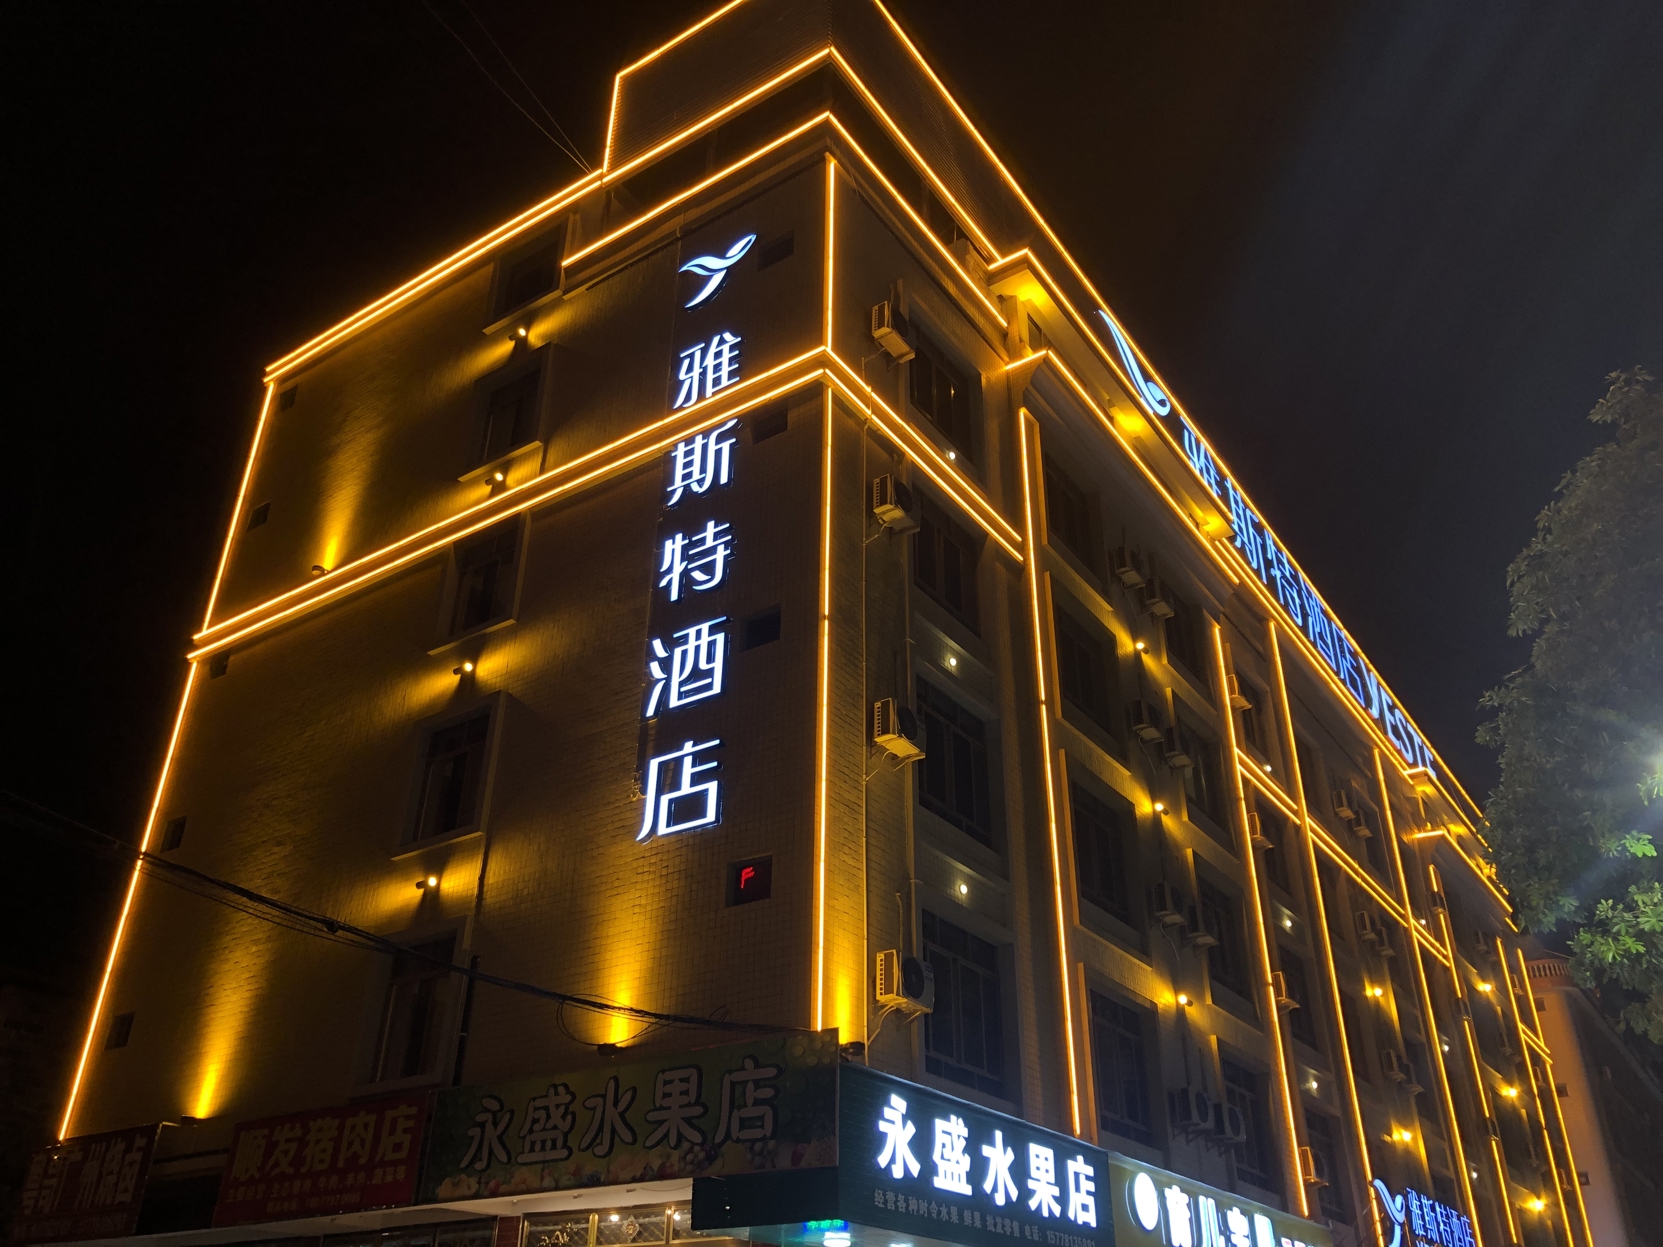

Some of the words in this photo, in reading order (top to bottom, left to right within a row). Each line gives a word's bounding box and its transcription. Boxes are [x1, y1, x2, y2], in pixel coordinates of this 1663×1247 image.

[636, 331, 742, 841] 雅斯特酒店
[230, 1105, 418, 1182] 顺发猪肉店
[459, 1056, 783, 1171] 永盛水果店
[877, 1094, 1097, 1228] 永盛水果店
[874, 1188, 960, 1224] 经营各种时令水果
[986, 1213, 1020, 1239] 批发零售
